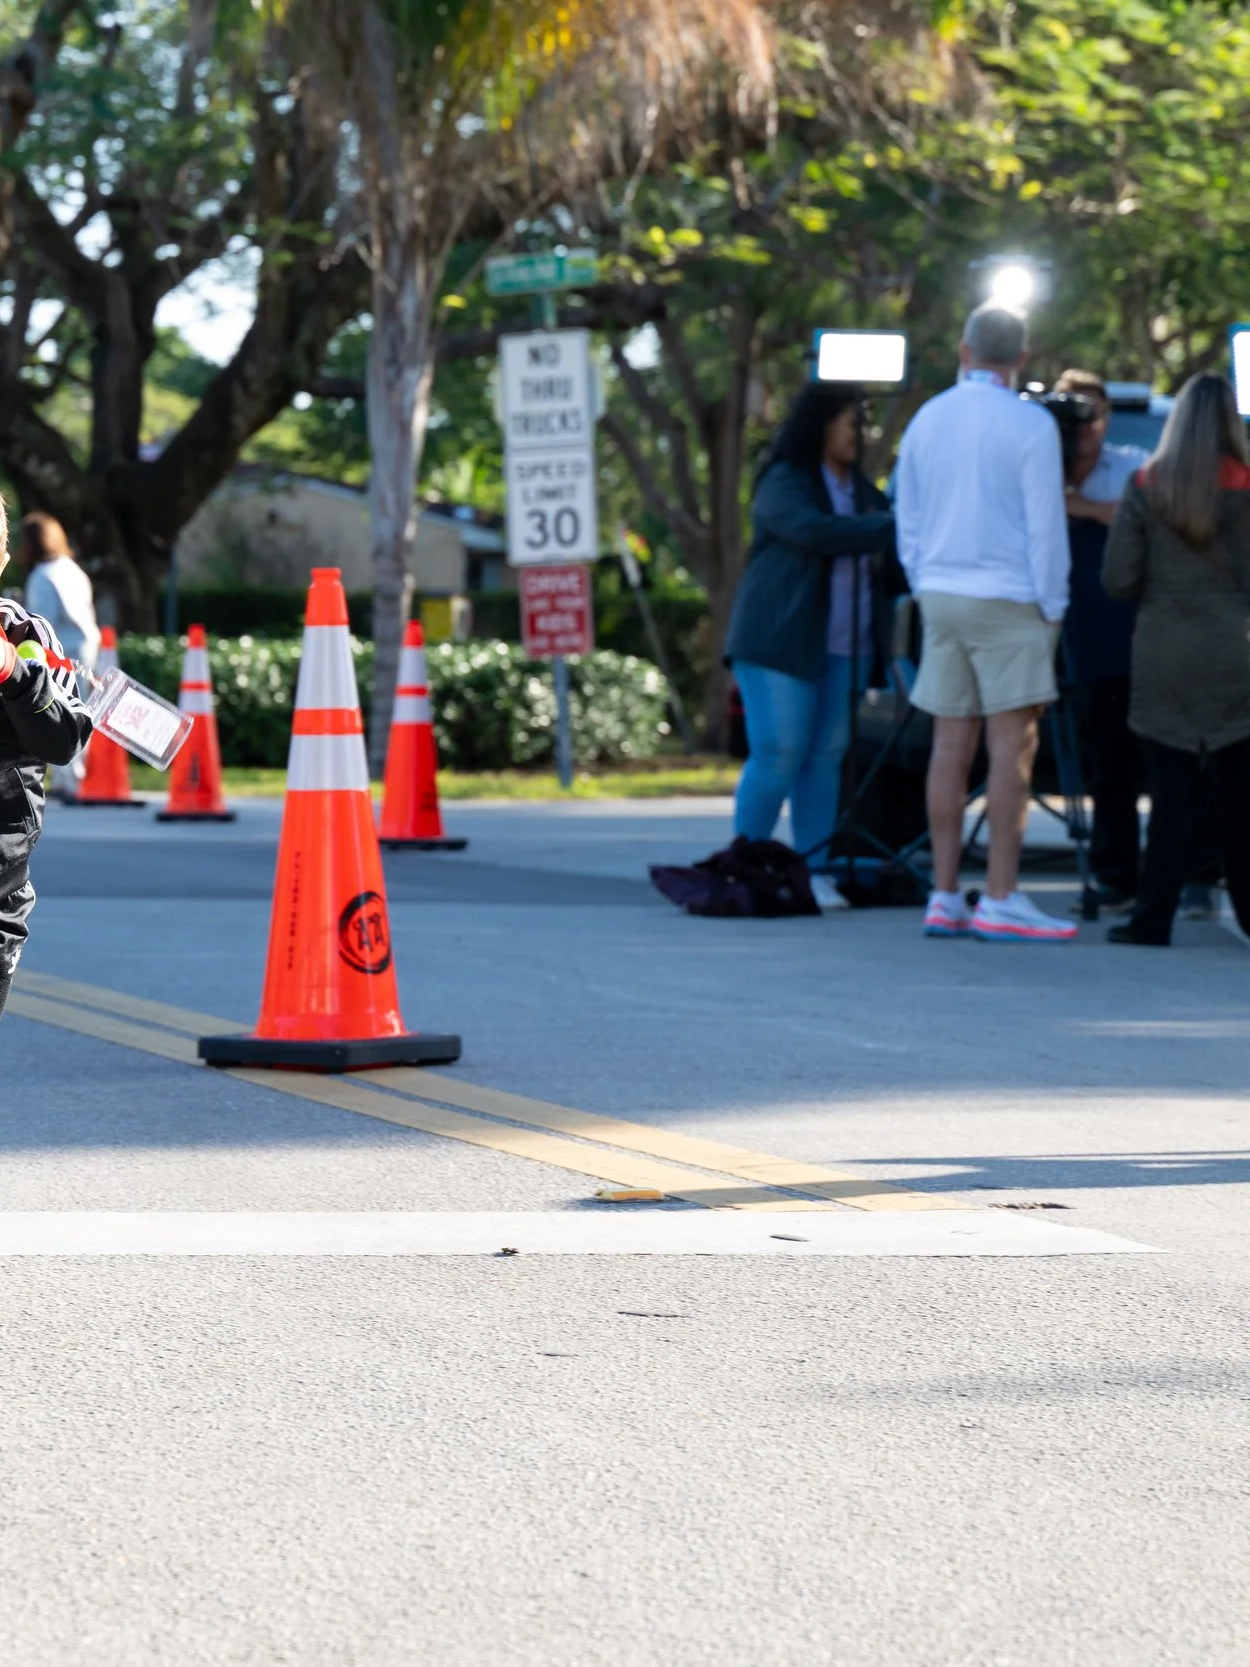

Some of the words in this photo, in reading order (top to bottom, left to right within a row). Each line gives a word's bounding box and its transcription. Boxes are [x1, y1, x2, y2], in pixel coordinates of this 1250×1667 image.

[528, 344, 561, 368] NO
[520, 377, 573, 401] THRU
[511, 409, 582, 434] TRUCKS
[516, 460, 586, 480] SPEED
[523, 506, 580, 551] 30
